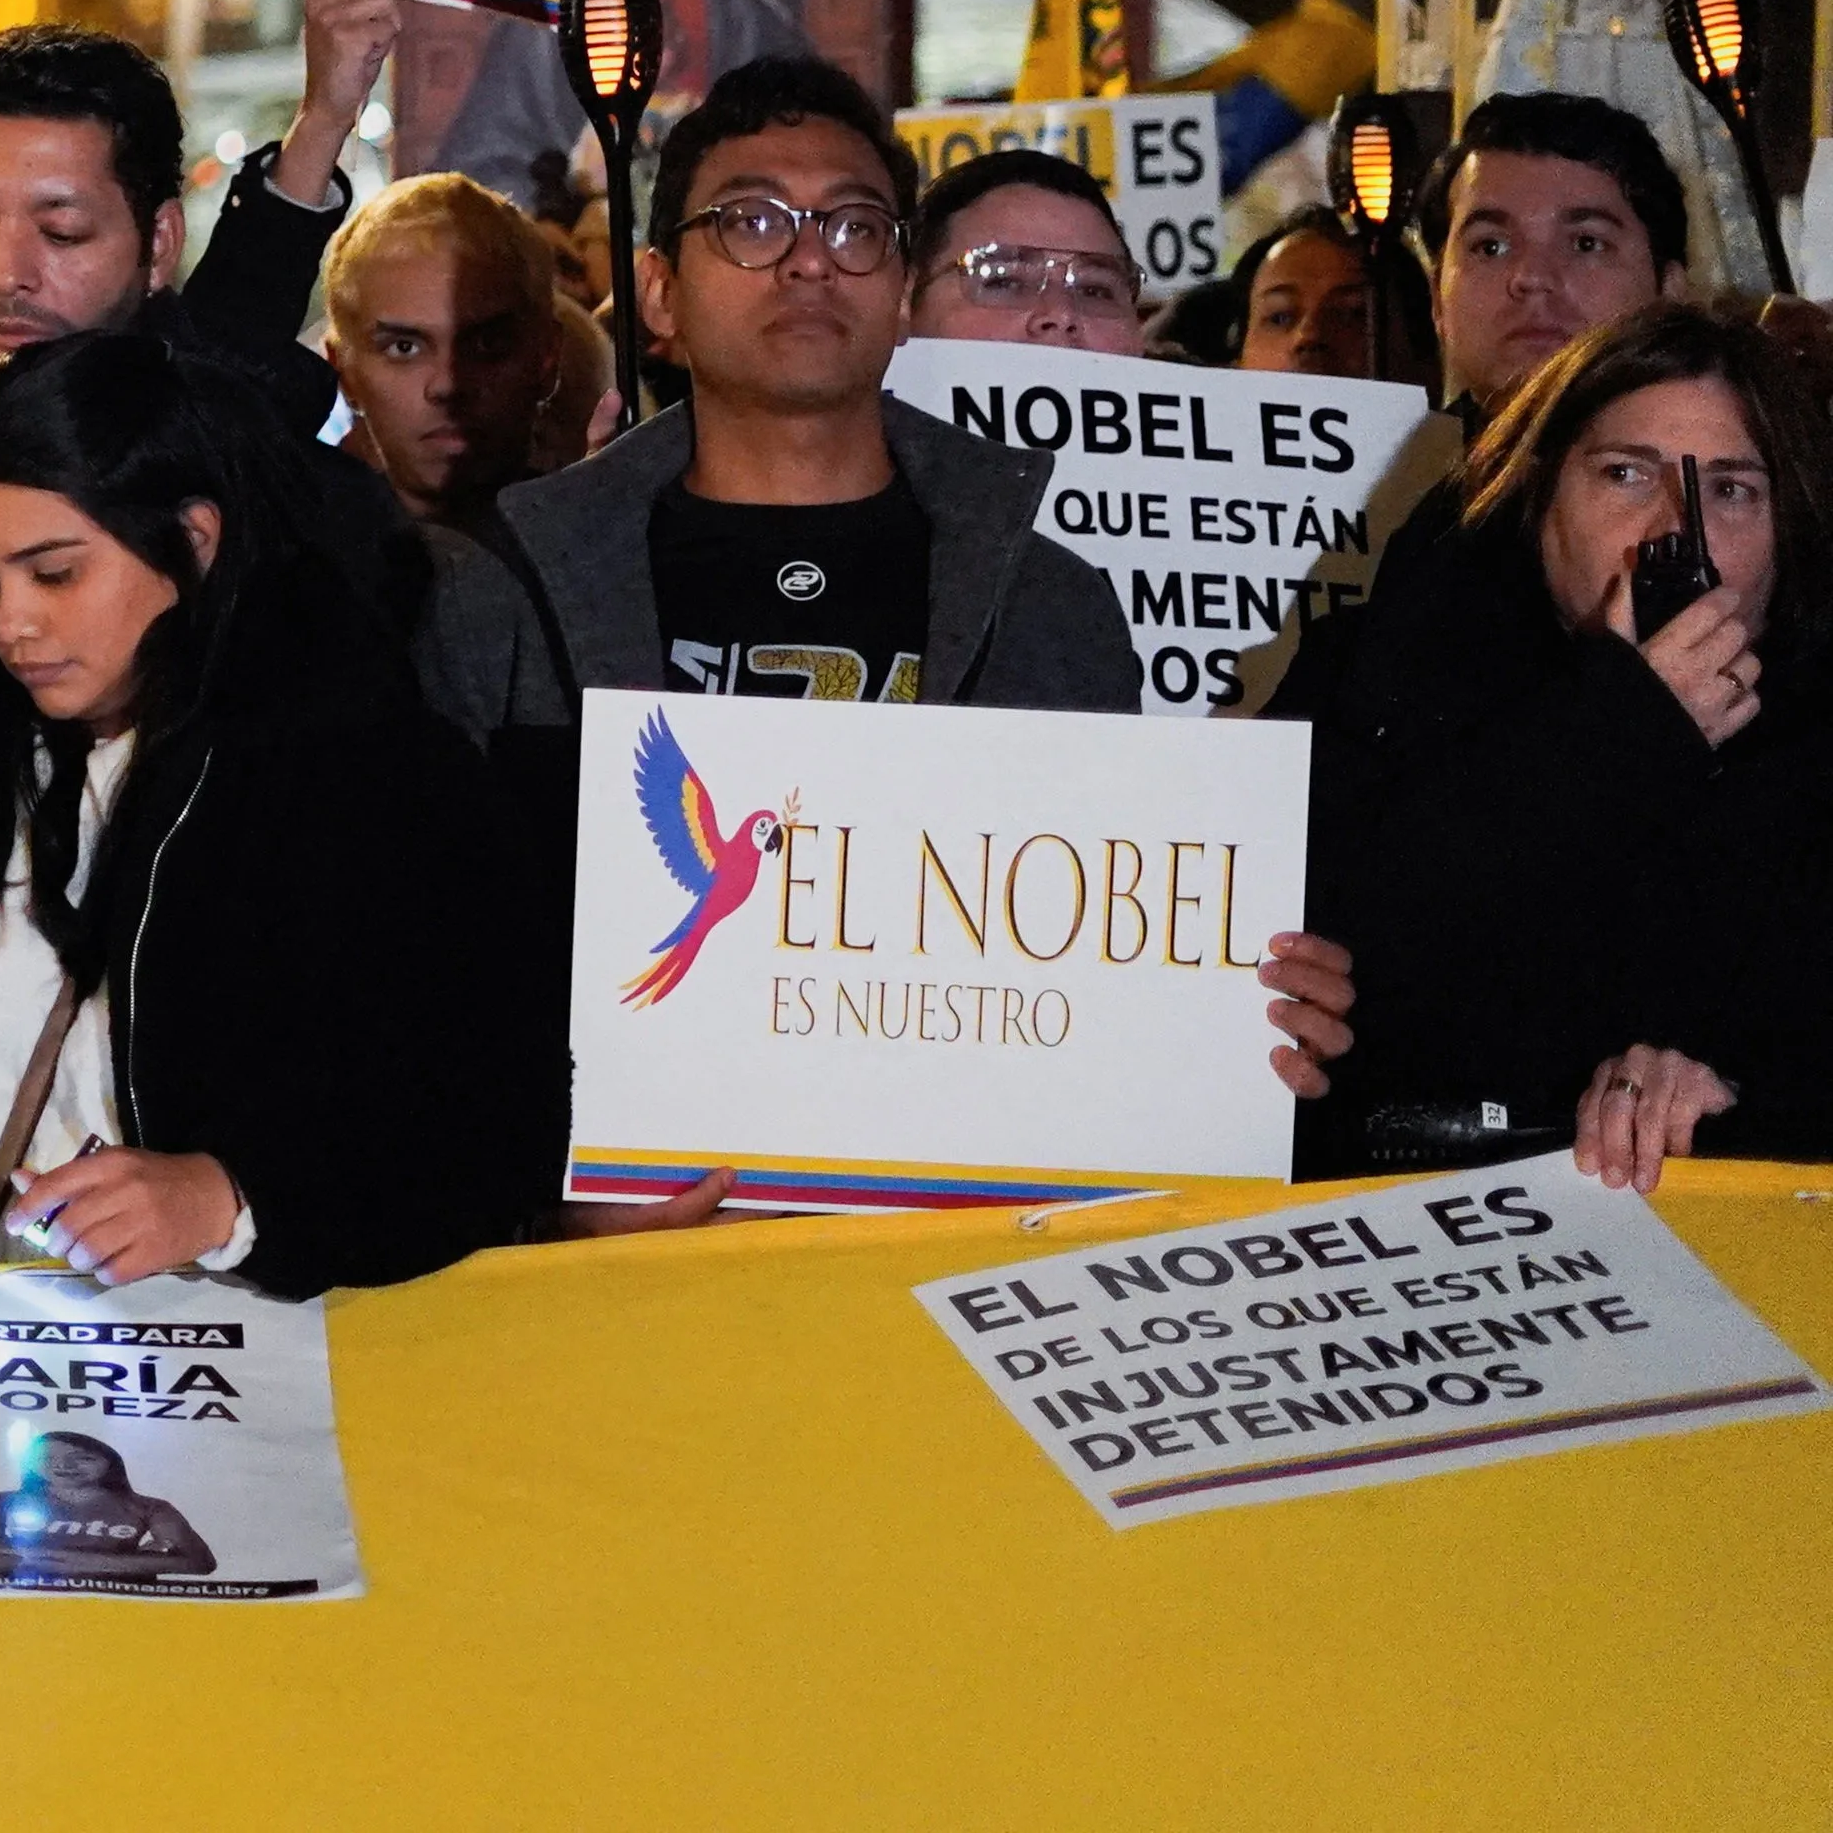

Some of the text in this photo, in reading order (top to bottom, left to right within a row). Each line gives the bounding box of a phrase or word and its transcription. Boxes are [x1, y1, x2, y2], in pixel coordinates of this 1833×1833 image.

[1133, 118, 1205, 188] ES
[1146, 217, 1219, 278] OS
[951, 385, 1355, 474] NOBEL ES
[1054, 488, 1369, 555] QUE ESTÁN
[1133, 645, 1244, 707] OS
[775, 823, 1263, 969] EL NOBEL
[771, 976, 1072, 1048] ES NUESTRO
[948, 1186, 1556, 1335] EL NOBEL ES
[111, 1327, 230, 1346] PARA
[995, 1249, 1612, 1382] DE LOS QUE ESTÁN
[1030, 1295, 1650, 1429] INJUSTAMENTE
[1069, 1361, 1546, 1472] DETENIDOS
